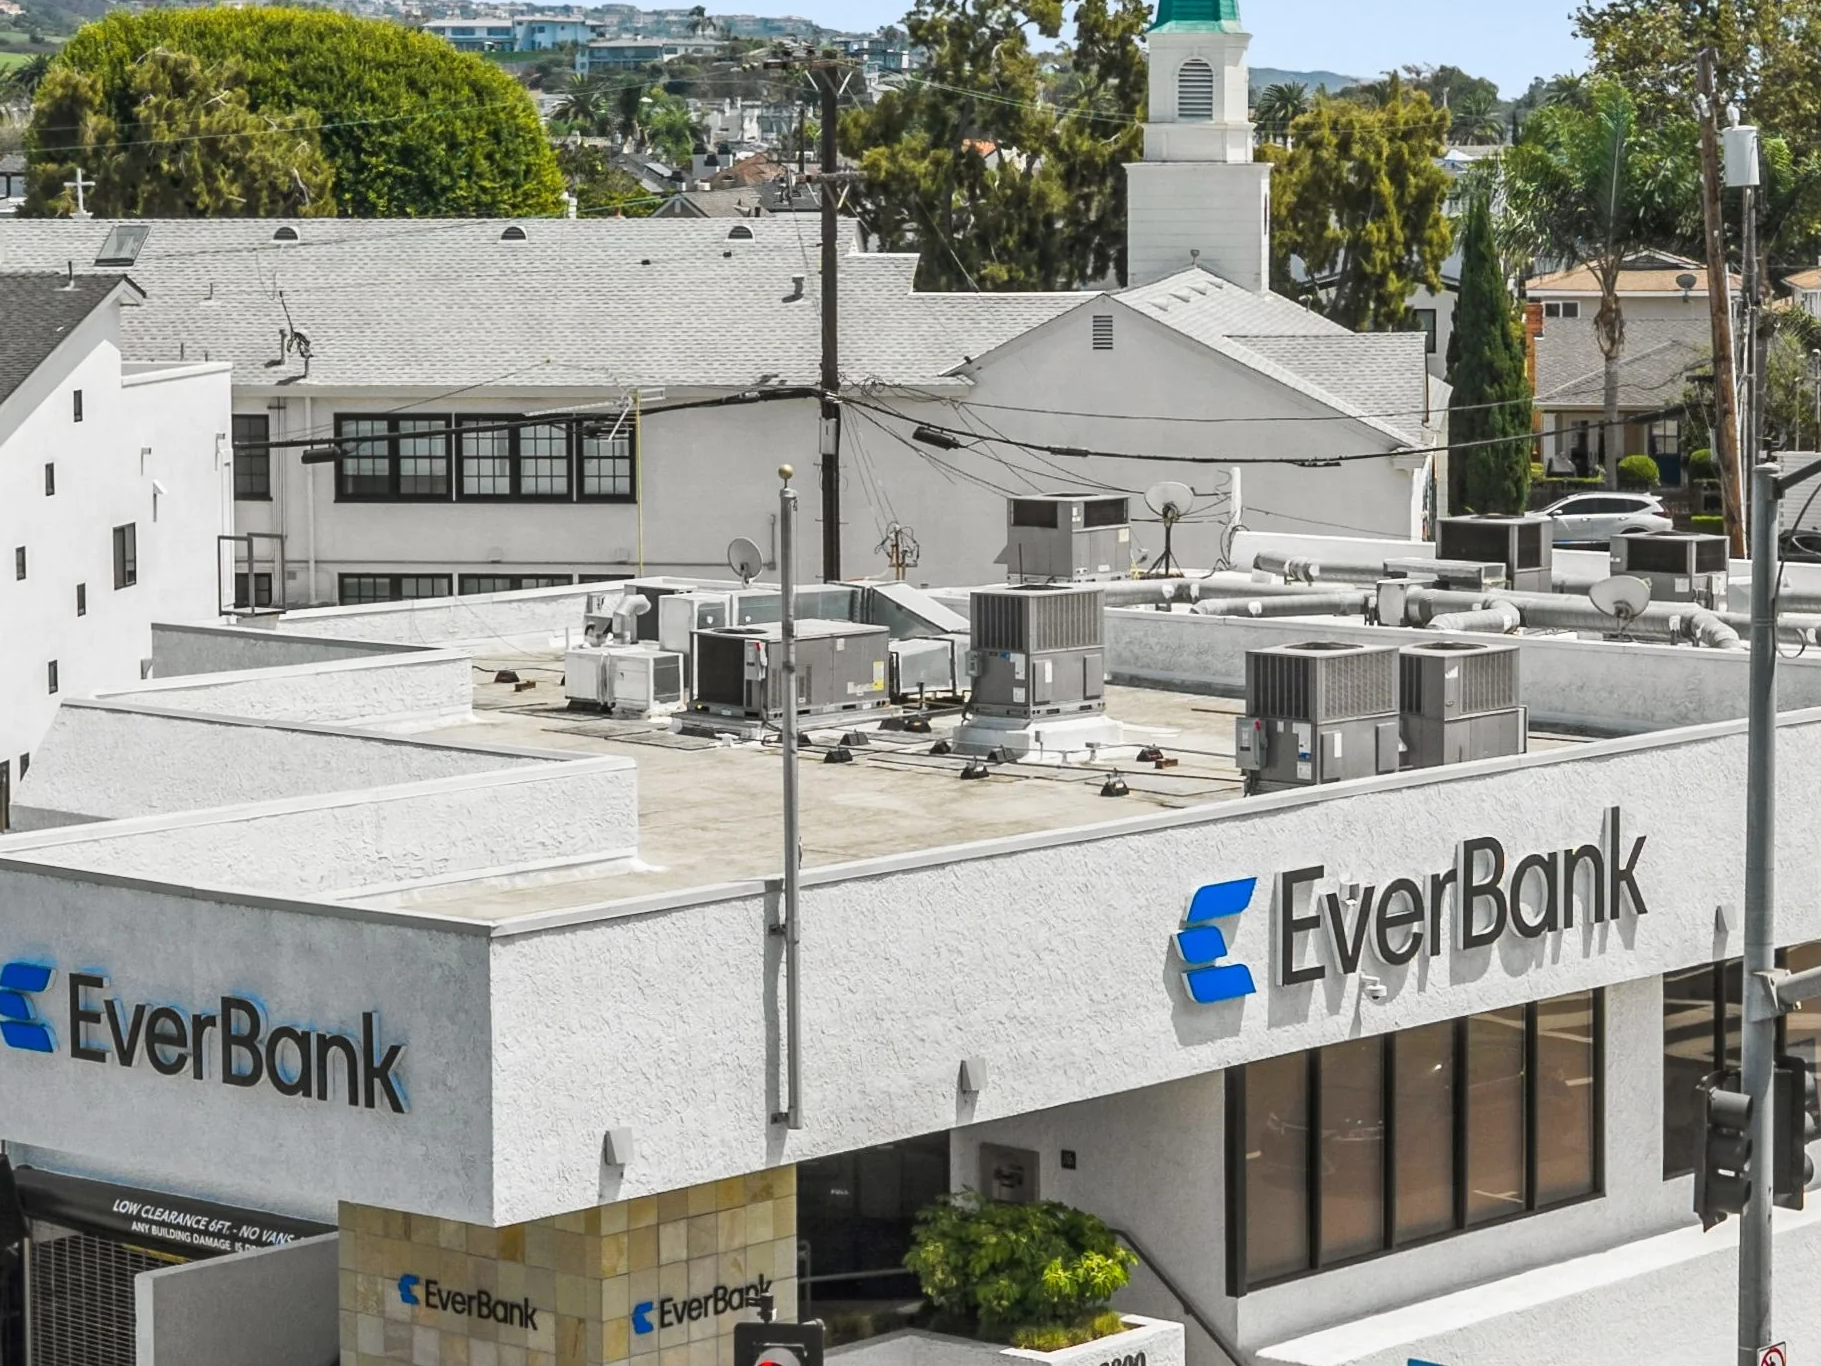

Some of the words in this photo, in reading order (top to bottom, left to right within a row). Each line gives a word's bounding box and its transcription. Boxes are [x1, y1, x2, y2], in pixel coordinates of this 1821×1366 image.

[1277, 806, 1647, 986] EverBank
[69, 973, 410, 1114] EverBank
[112, 1199, 137, 1215] LOW
[141, 1205, 208, 1230] CLEARANCE
[239, 1225, 260, 1240] NO
[131, 1221, 150, 1234] ANY
[151, 1225, 192, 1243] BUILDING
[193, 1234, 231, 1251] DAMAGE
[425, 1279, 538, 1331] EverBank
